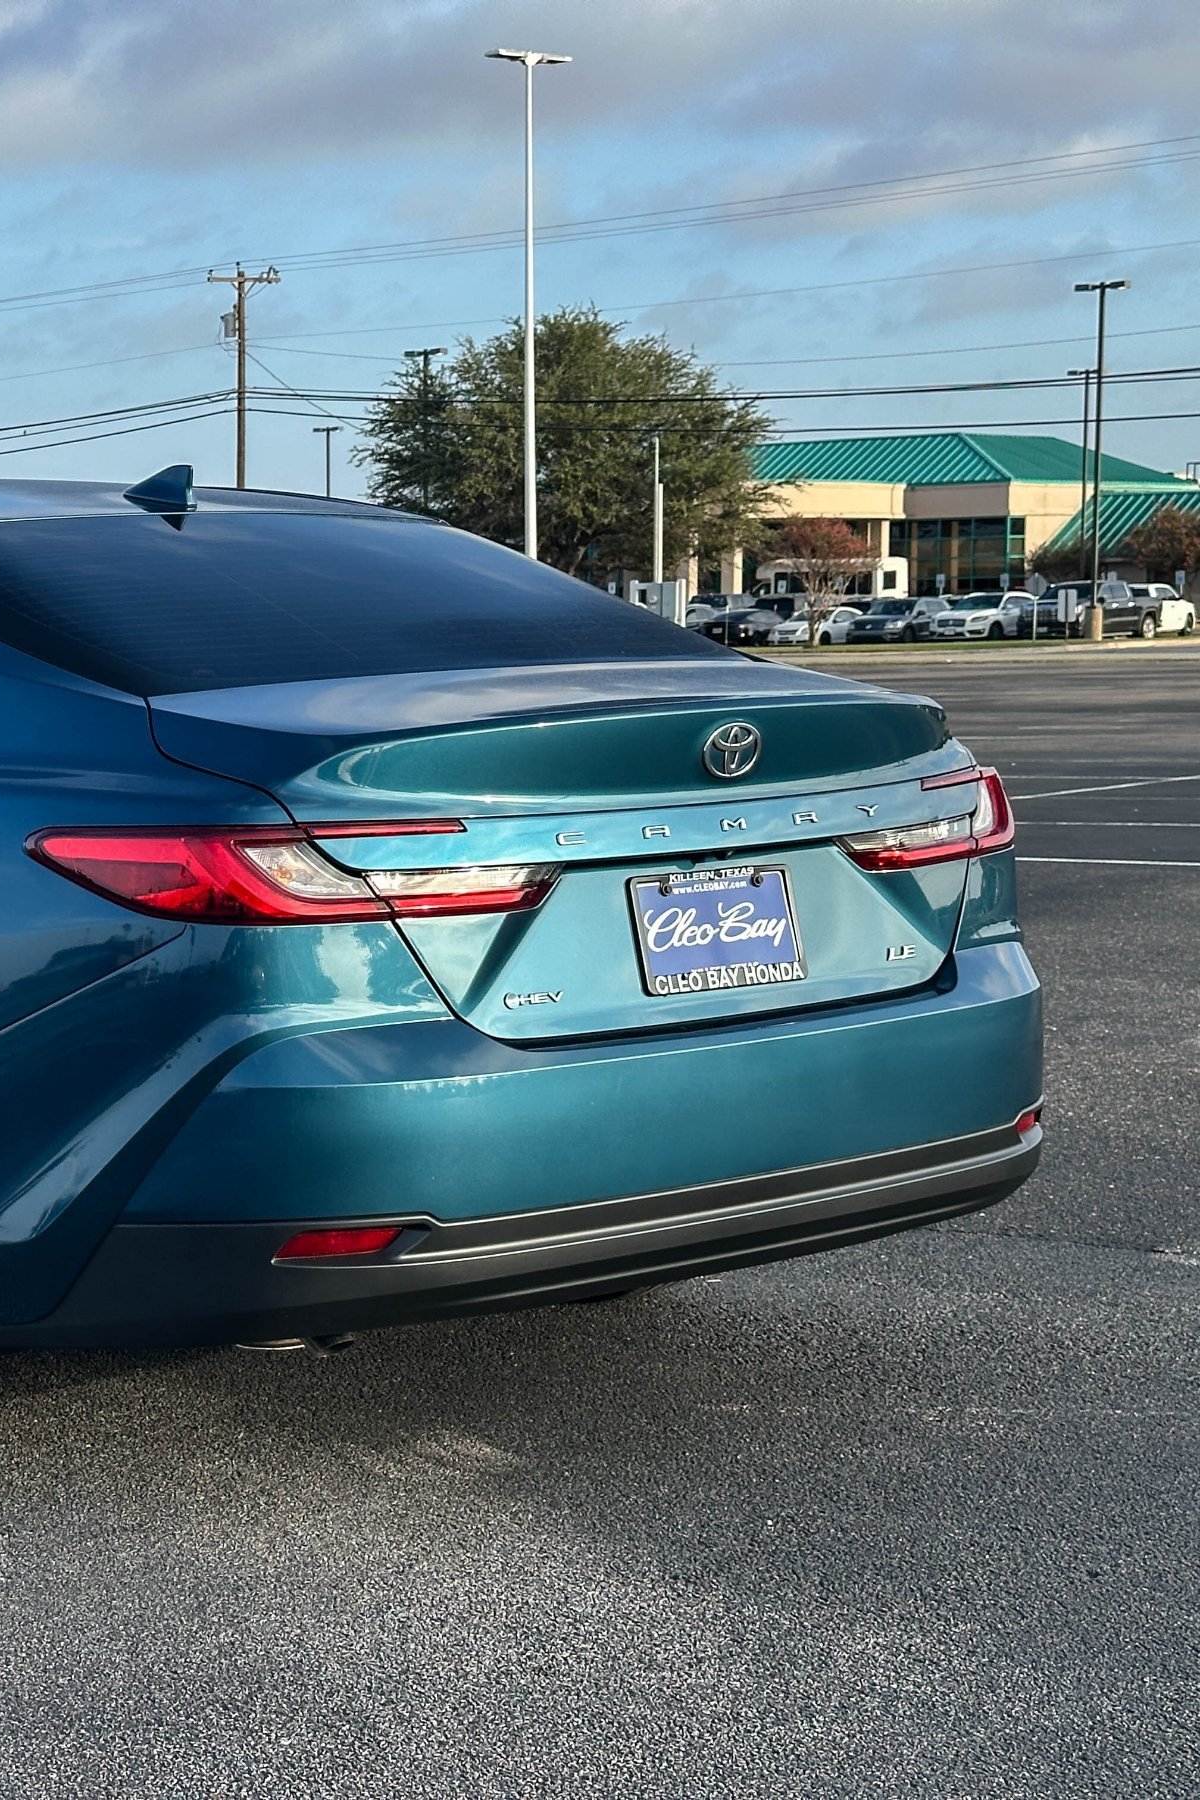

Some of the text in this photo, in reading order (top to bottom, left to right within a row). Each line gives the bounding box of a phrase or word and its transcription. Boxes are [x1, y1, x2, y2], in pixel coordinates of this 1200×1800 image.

[555, 803, 879, 846] CAMRY
[720, 866, 755, 878] TEXAS
[672, 880, 748, 895] www.CLEOBAY.com
[643, 901, 787, 952] Cleo Bay
[887, 943, 917, 961] LE
[655, 972, 703, 995] CLEO
[707, 967, 741, 988] BAY
[744, 960, 805, 985] HONDA
